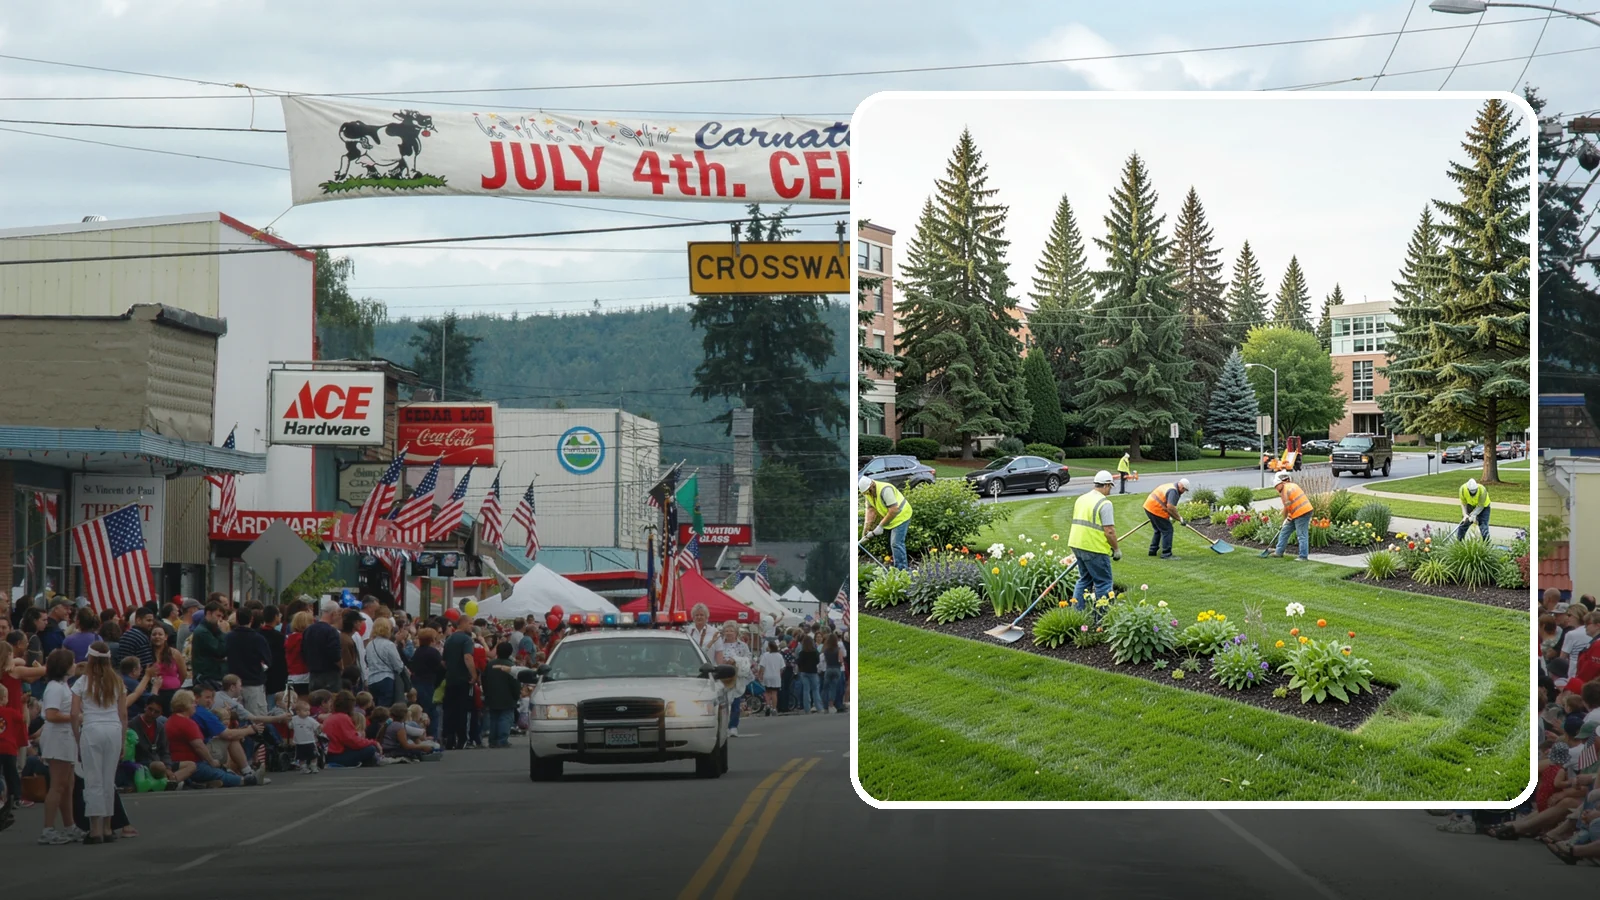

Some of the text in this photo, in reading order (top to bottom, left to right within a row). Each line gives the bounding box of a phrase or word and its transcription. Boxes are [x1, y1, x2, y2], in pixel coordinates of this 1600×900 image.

[481, 141, 604, 192] JULY
[632, 150, 746, 197] 4th.
[697, 254, 850, 280] CROSSWA
[283, 380, 373, 420] ACE
[405, 409, 452, 422] CEDAR
[283, 421, 371, 436] Hardware
[416, 428, 477, 447] Coca-Cola
[83, 485, 155, 495] St. Vincent de Paul
[213, 517, 330, 535] HARDARE
[688, 527, 741, 535] CRNATION
[699, 535, 730, 543] GLASS
